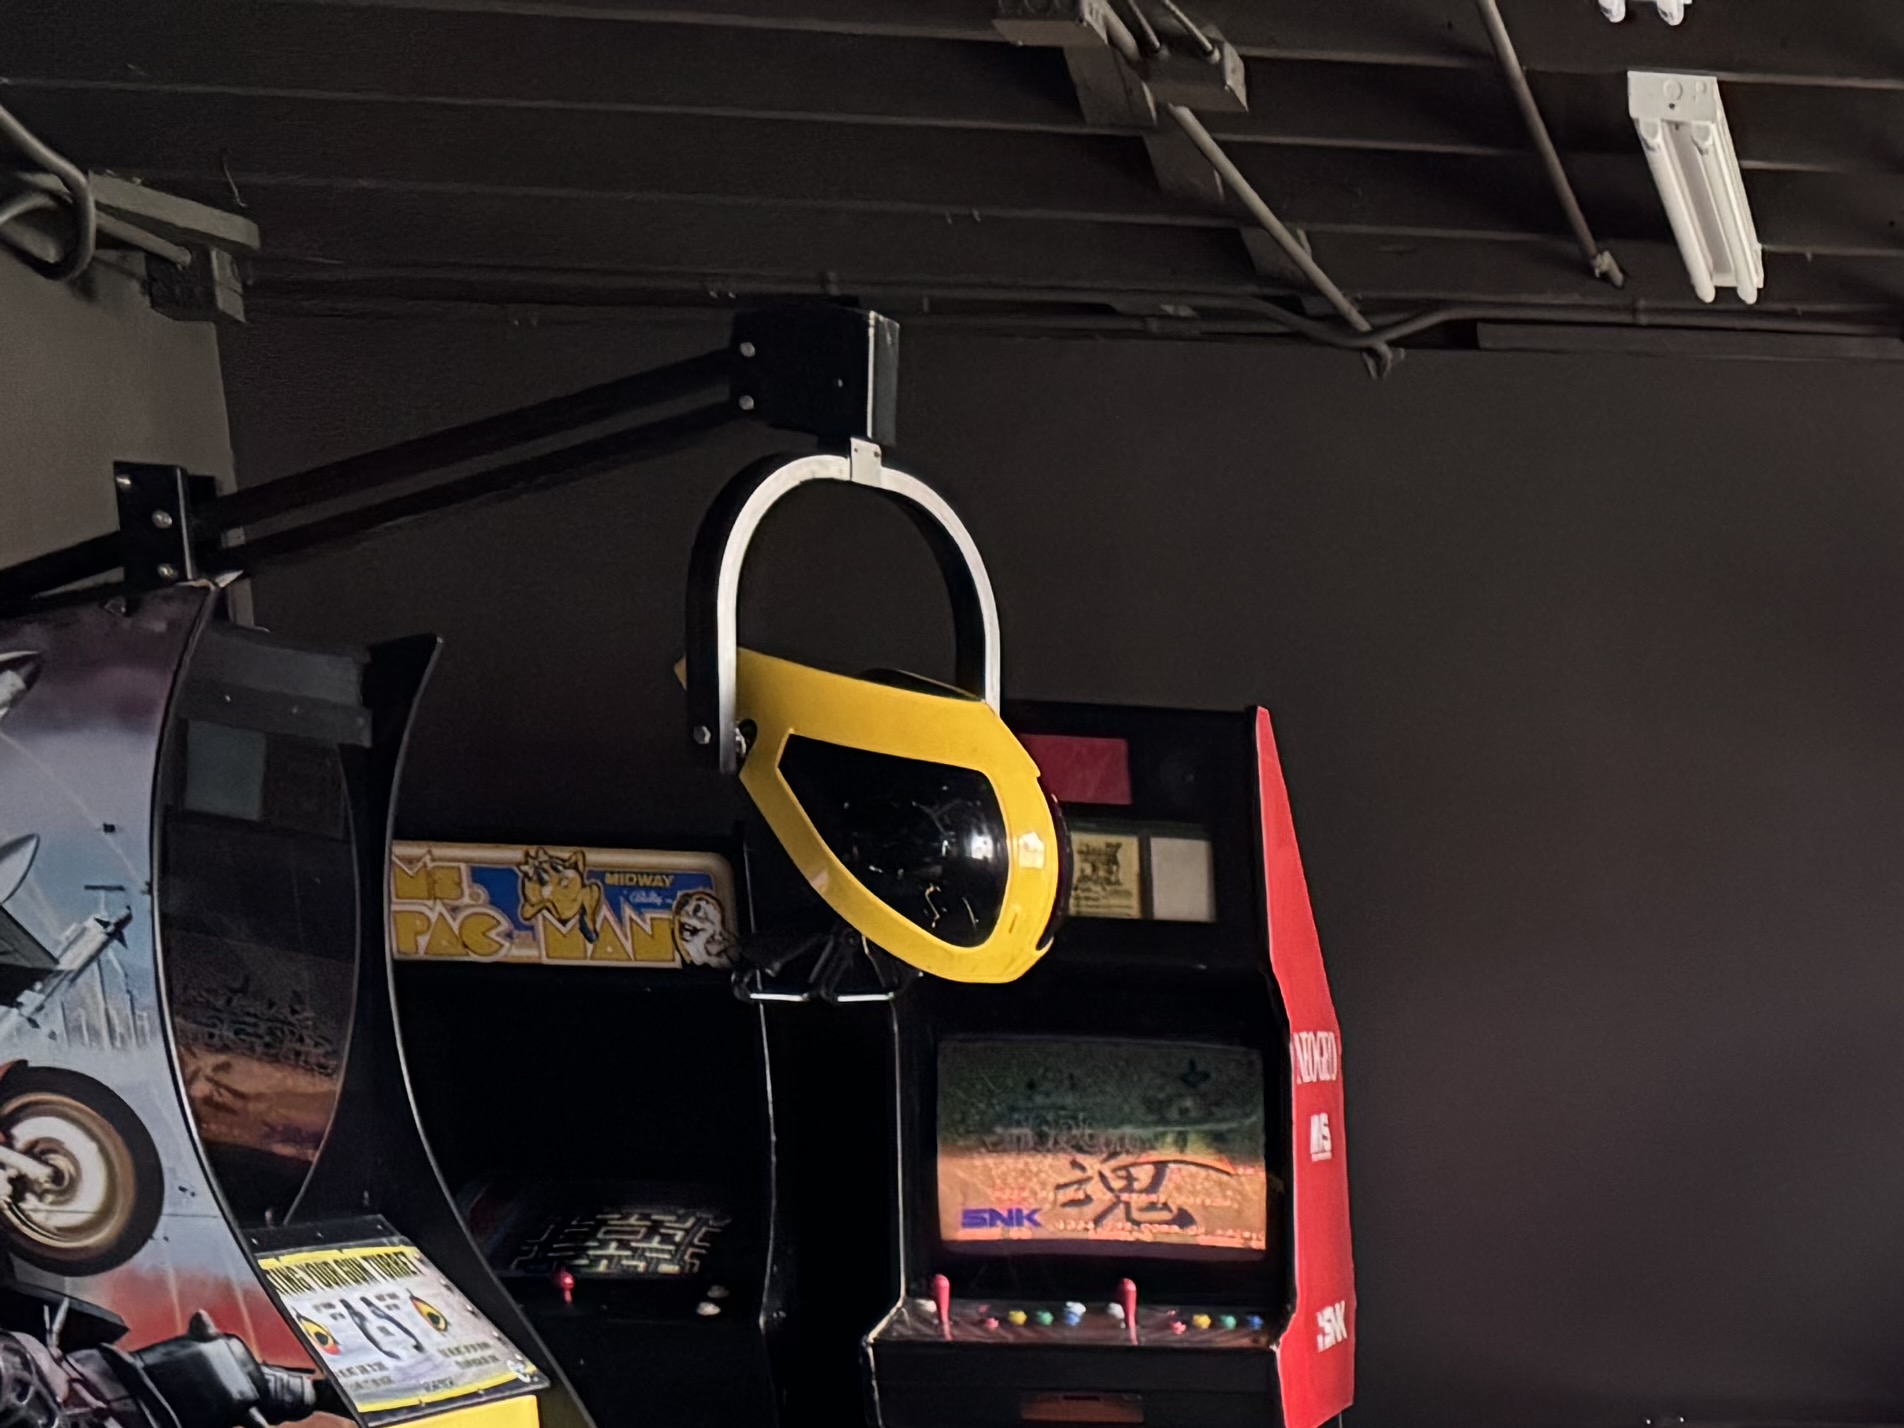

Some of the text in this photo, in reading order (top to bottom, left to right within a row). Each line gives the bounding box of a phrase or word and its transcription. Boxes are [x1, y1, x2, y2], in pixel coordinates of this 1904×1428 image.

[605, 872, 675, 888] MIDWAY
[391, 904, 678, 963] PAC-MAN
[961, 1208, 1042, 1228] SNK
[294, 1259, 353, 1292] YOUR
[360, 1251, 424, 1282] TURRET
